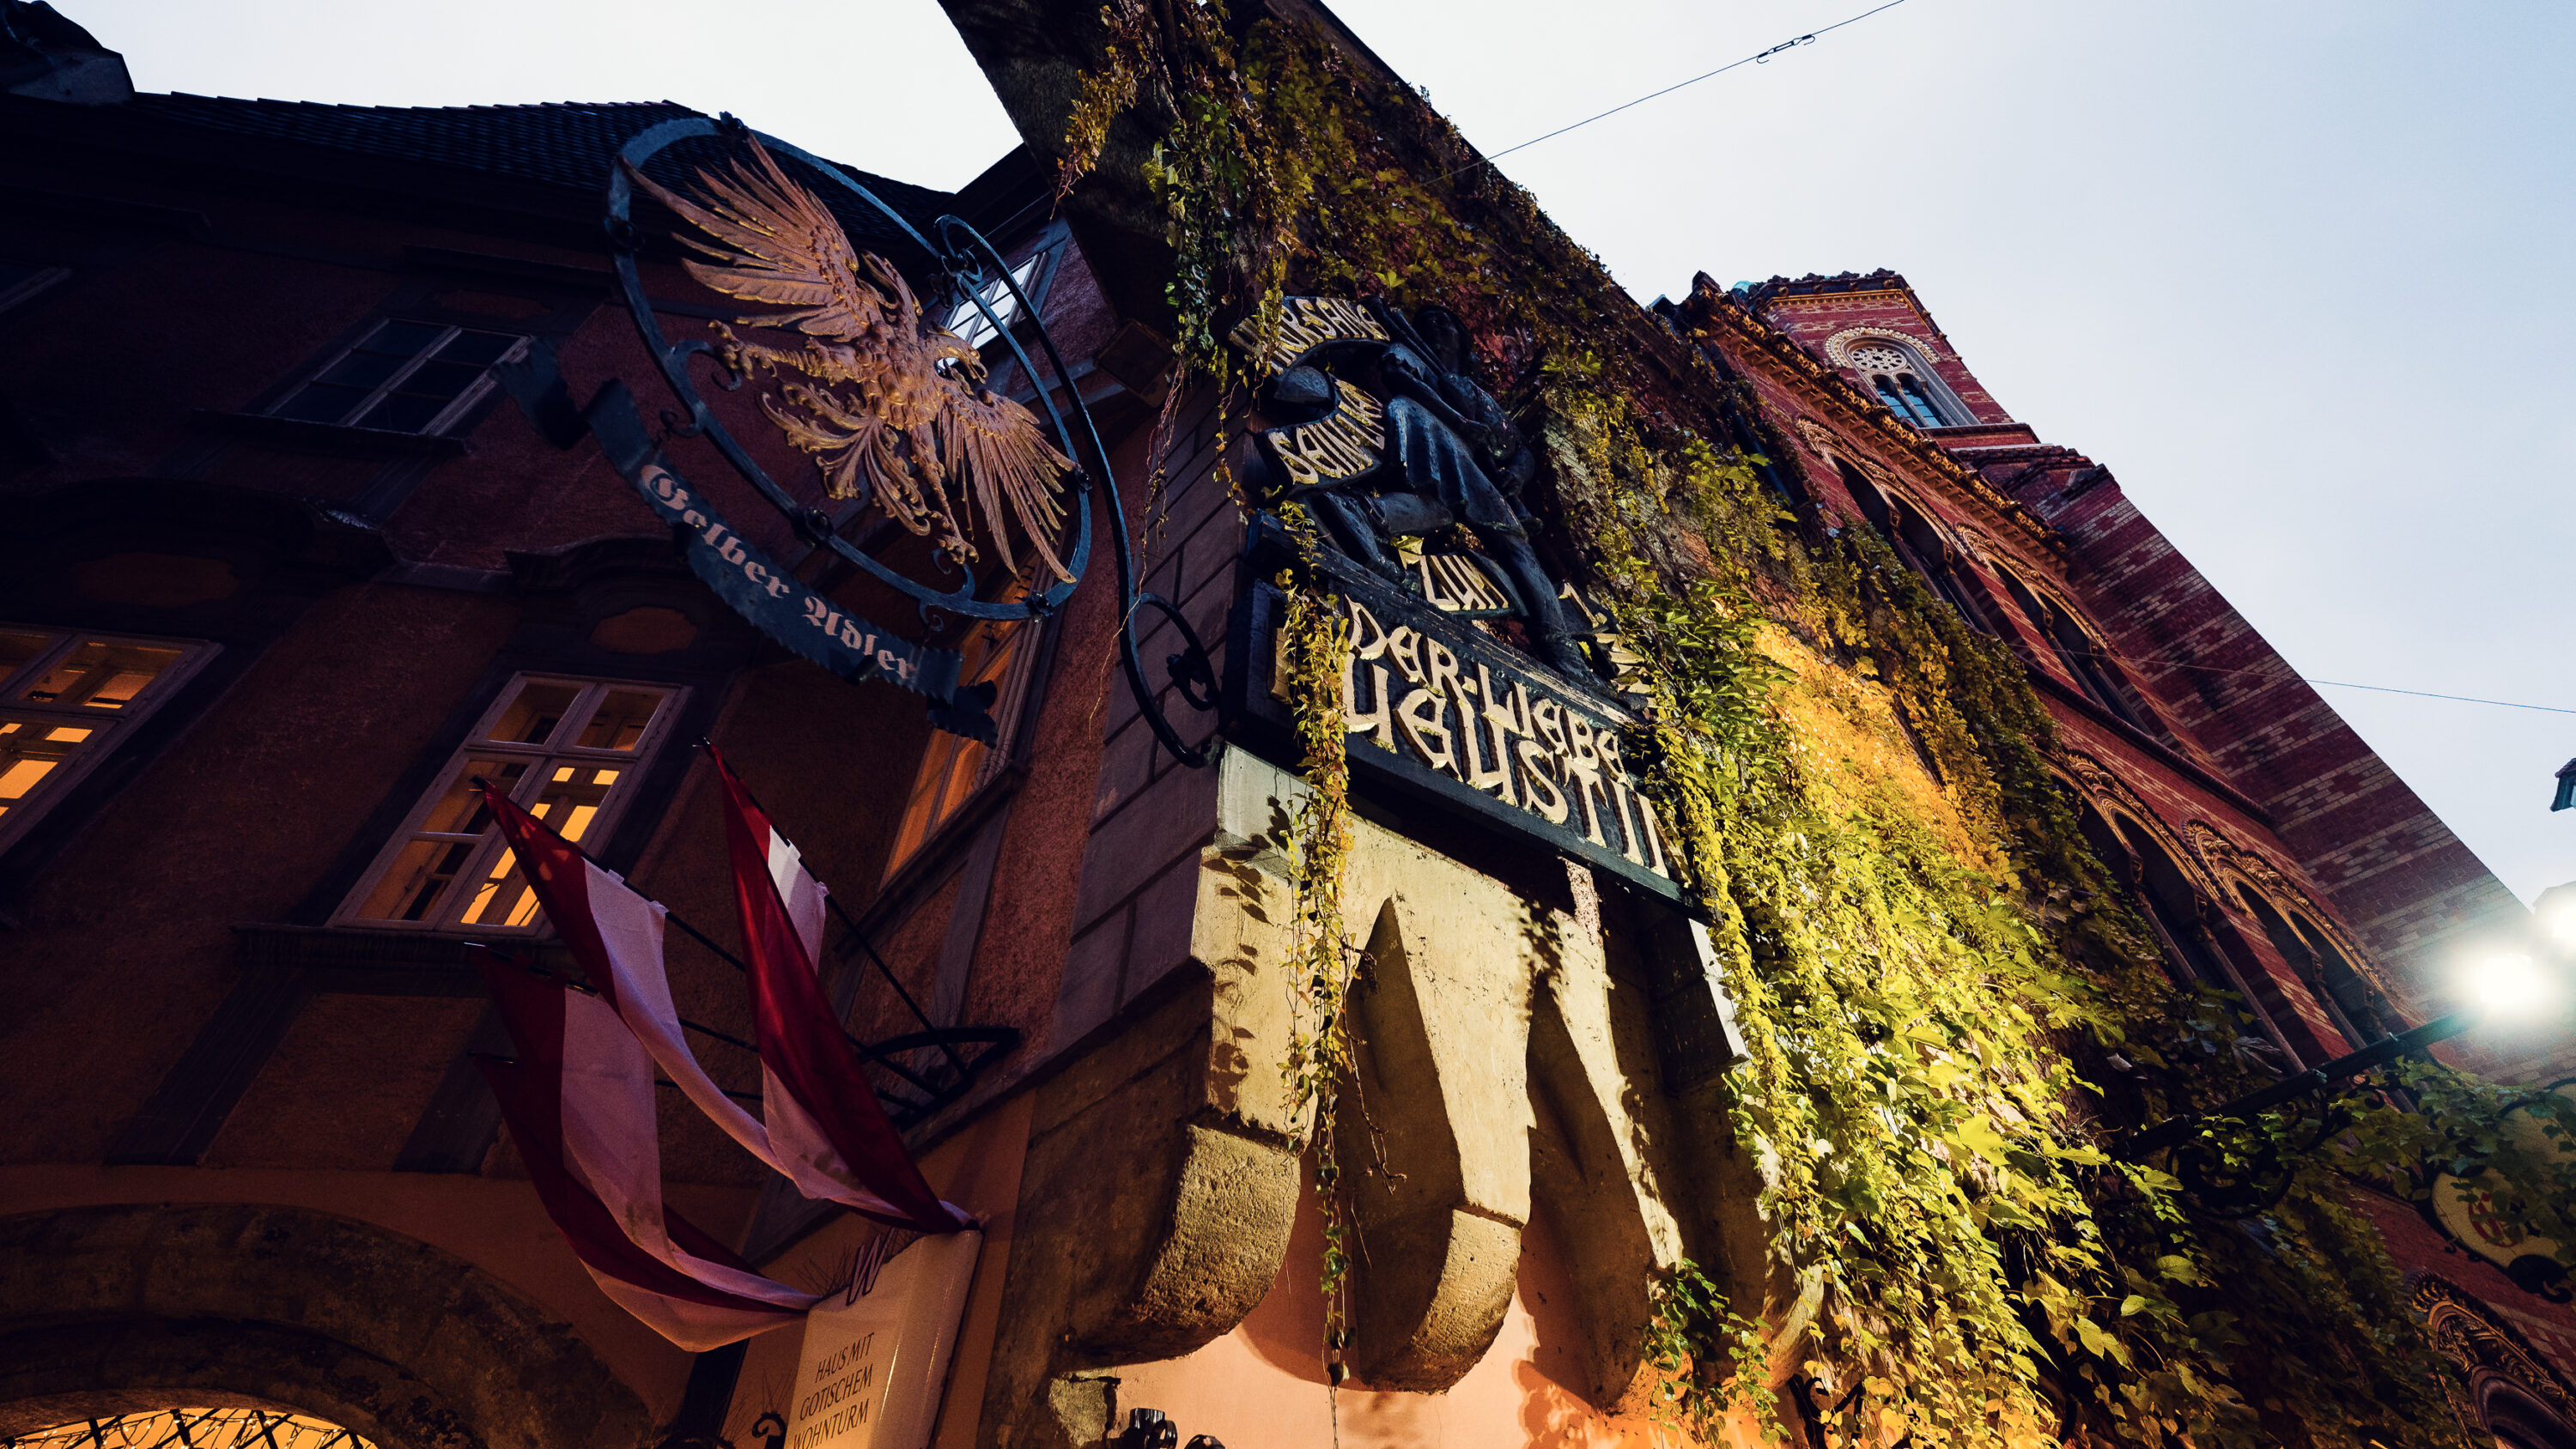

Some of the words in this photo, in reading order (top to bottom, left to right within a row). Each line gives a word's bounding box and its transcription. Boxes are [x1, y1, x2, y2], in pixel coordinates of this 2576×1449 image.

[640, 464, 790, 598] Gelber
[802, 596, 916, 679] Adler
[815, 1346, 848, 1384] HAUS
[846, 1331, 875, 1367] MIT
[799, 1362, 873, 1422] GOTISCHEM
[793, 1397, 870, 1449] WOHNTURM
